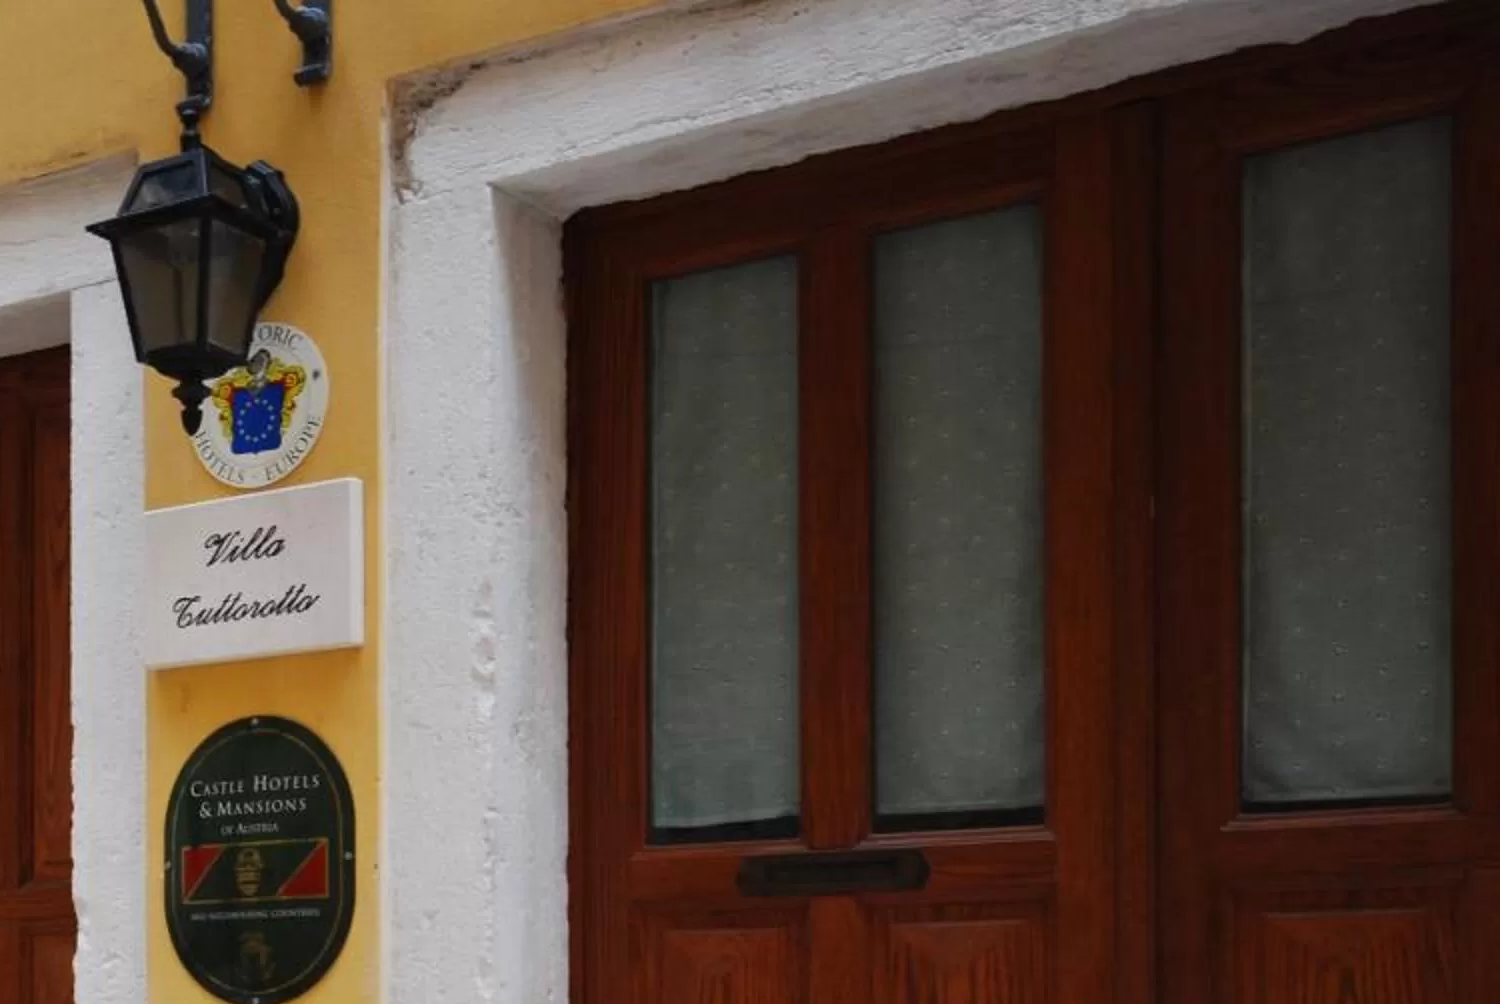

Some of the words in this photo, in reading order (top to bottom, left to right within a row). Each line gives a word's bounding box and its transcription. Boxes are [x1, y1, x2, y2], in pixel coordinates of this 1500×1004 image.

[263, 417, 320, 481] EUROPE
[204, 525, 286, 567] Villa
[172, 583, 321, 628] Tuttorotto
[190, 780, 245, 798] CASTLE
[252, 775, 320, 792] HOTELS
[199, 801, 212, 818] &
[217, 798, 307, 816] MANSIONS
